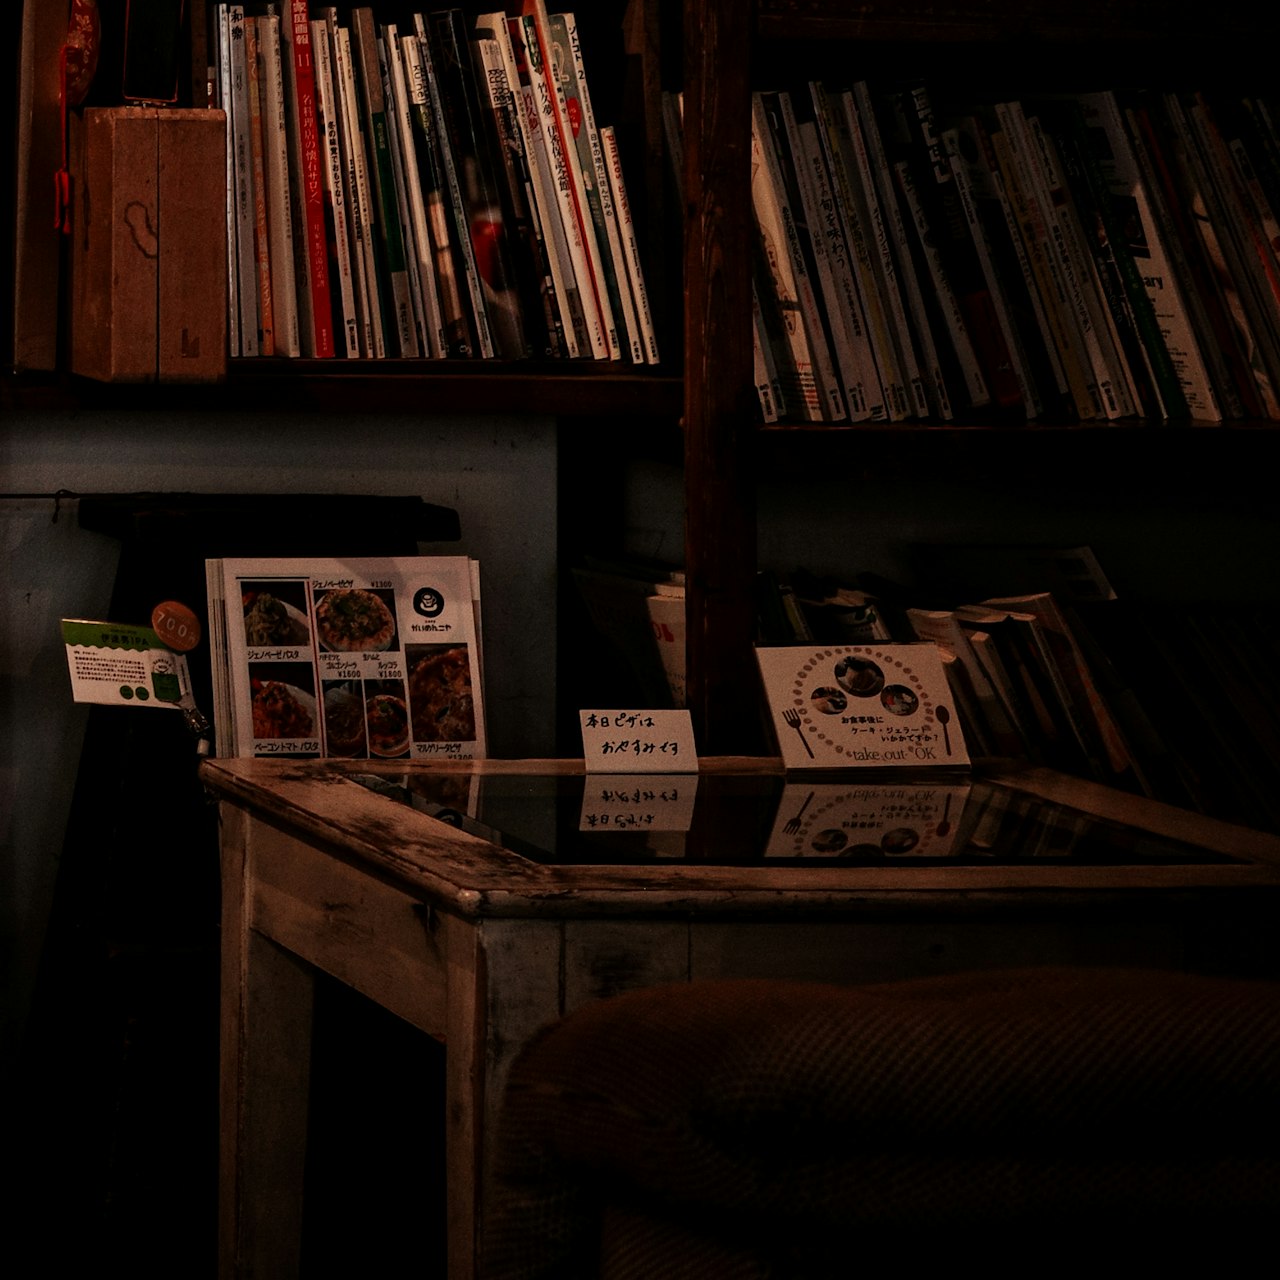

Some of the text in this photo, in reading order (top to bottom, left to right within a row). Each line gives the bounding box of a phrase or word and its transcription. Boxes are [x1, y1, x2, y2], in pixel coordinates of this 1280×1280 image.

[156, 611, 189, 638] 700
[283, 650, 300, 659] パスタ
[585, 713, 656, 729] 本日ピザは
[850, 726, 932, 736] ケーキ・ジェラート
[881, 733, 939, 743] いかがですか?
[300, 741, 320, 752] パスタ
[415, 742, 462, 753] マルゲリータピザ
[601, 739, 680, 757] おやすみです
[852, 747, 938, 762] take out OK
